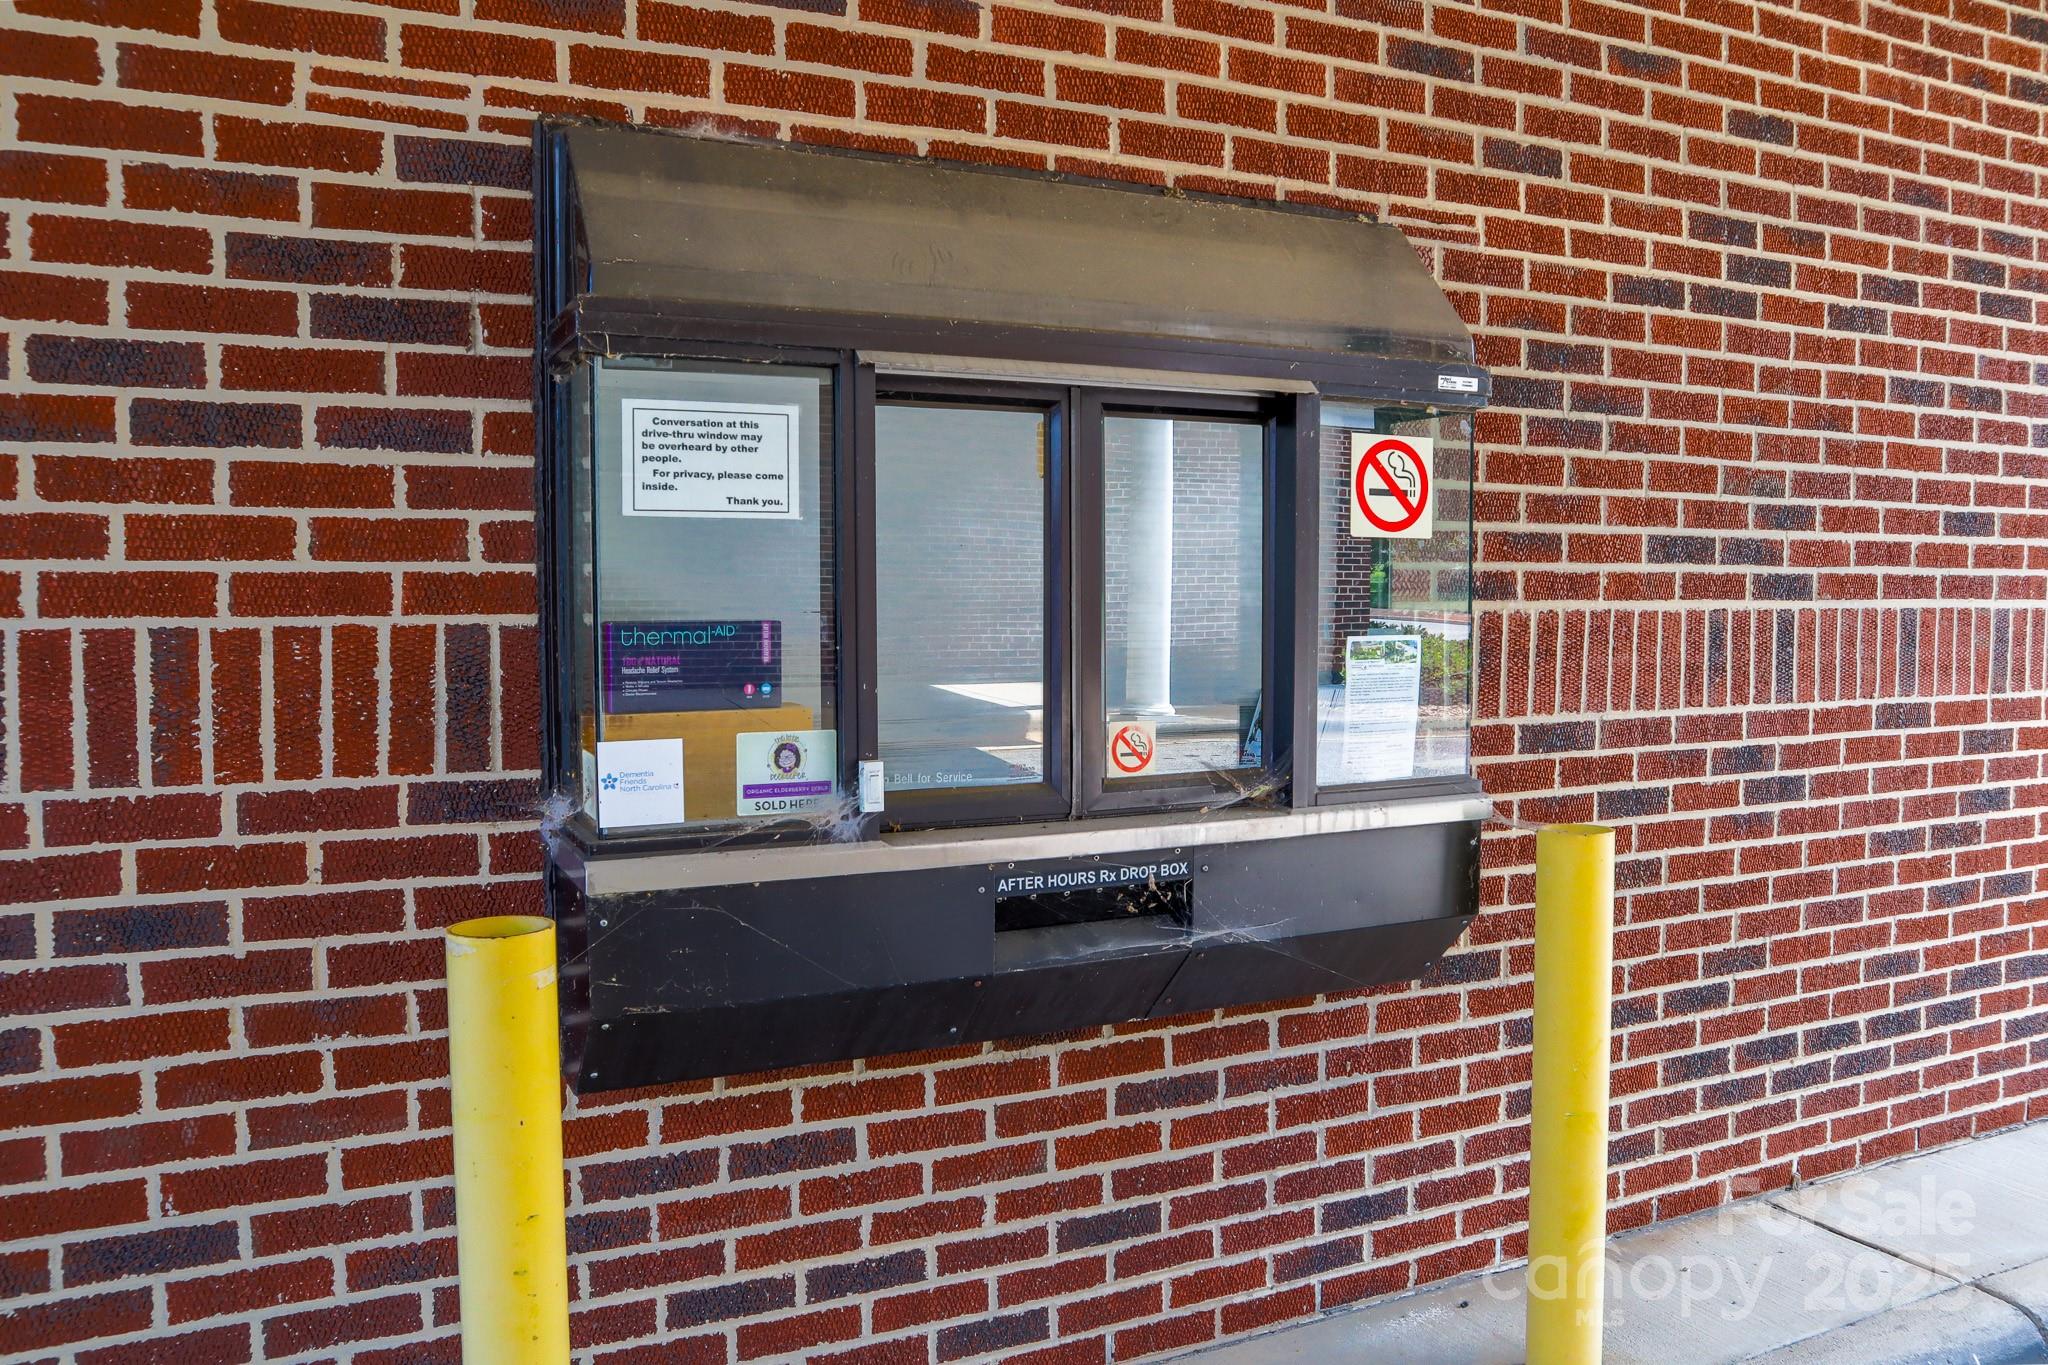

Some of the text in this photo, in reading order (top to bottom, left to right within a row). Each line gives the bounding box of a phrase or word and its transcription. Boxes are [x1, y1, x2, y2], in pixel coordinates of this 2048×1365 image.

[652, 417, 759, 429] Conversation at this
[641, 429, 763, 443] drive-thru window may
[641, 441, 759, 453] be overheard by other
[641, 454, 682, 464] people.
[652, 469, 670, 478] For
[673, 470, 715, 480] privacy,
[717, 471, 752, 481] please
[641, 482, 678, 491] inside.
[726, 496, 784, 507] Thank you.
[621, 665, 679, 675] Headache Relief System
[894, 773, 913, 784] Bell
[917, 773, 931, 783] for
[936, 771, 973, 783] Service
[755, 800, 787, 811] SOLD
[998, 862, 1188, 892] AFTER HOURS Rx DROP BOX
